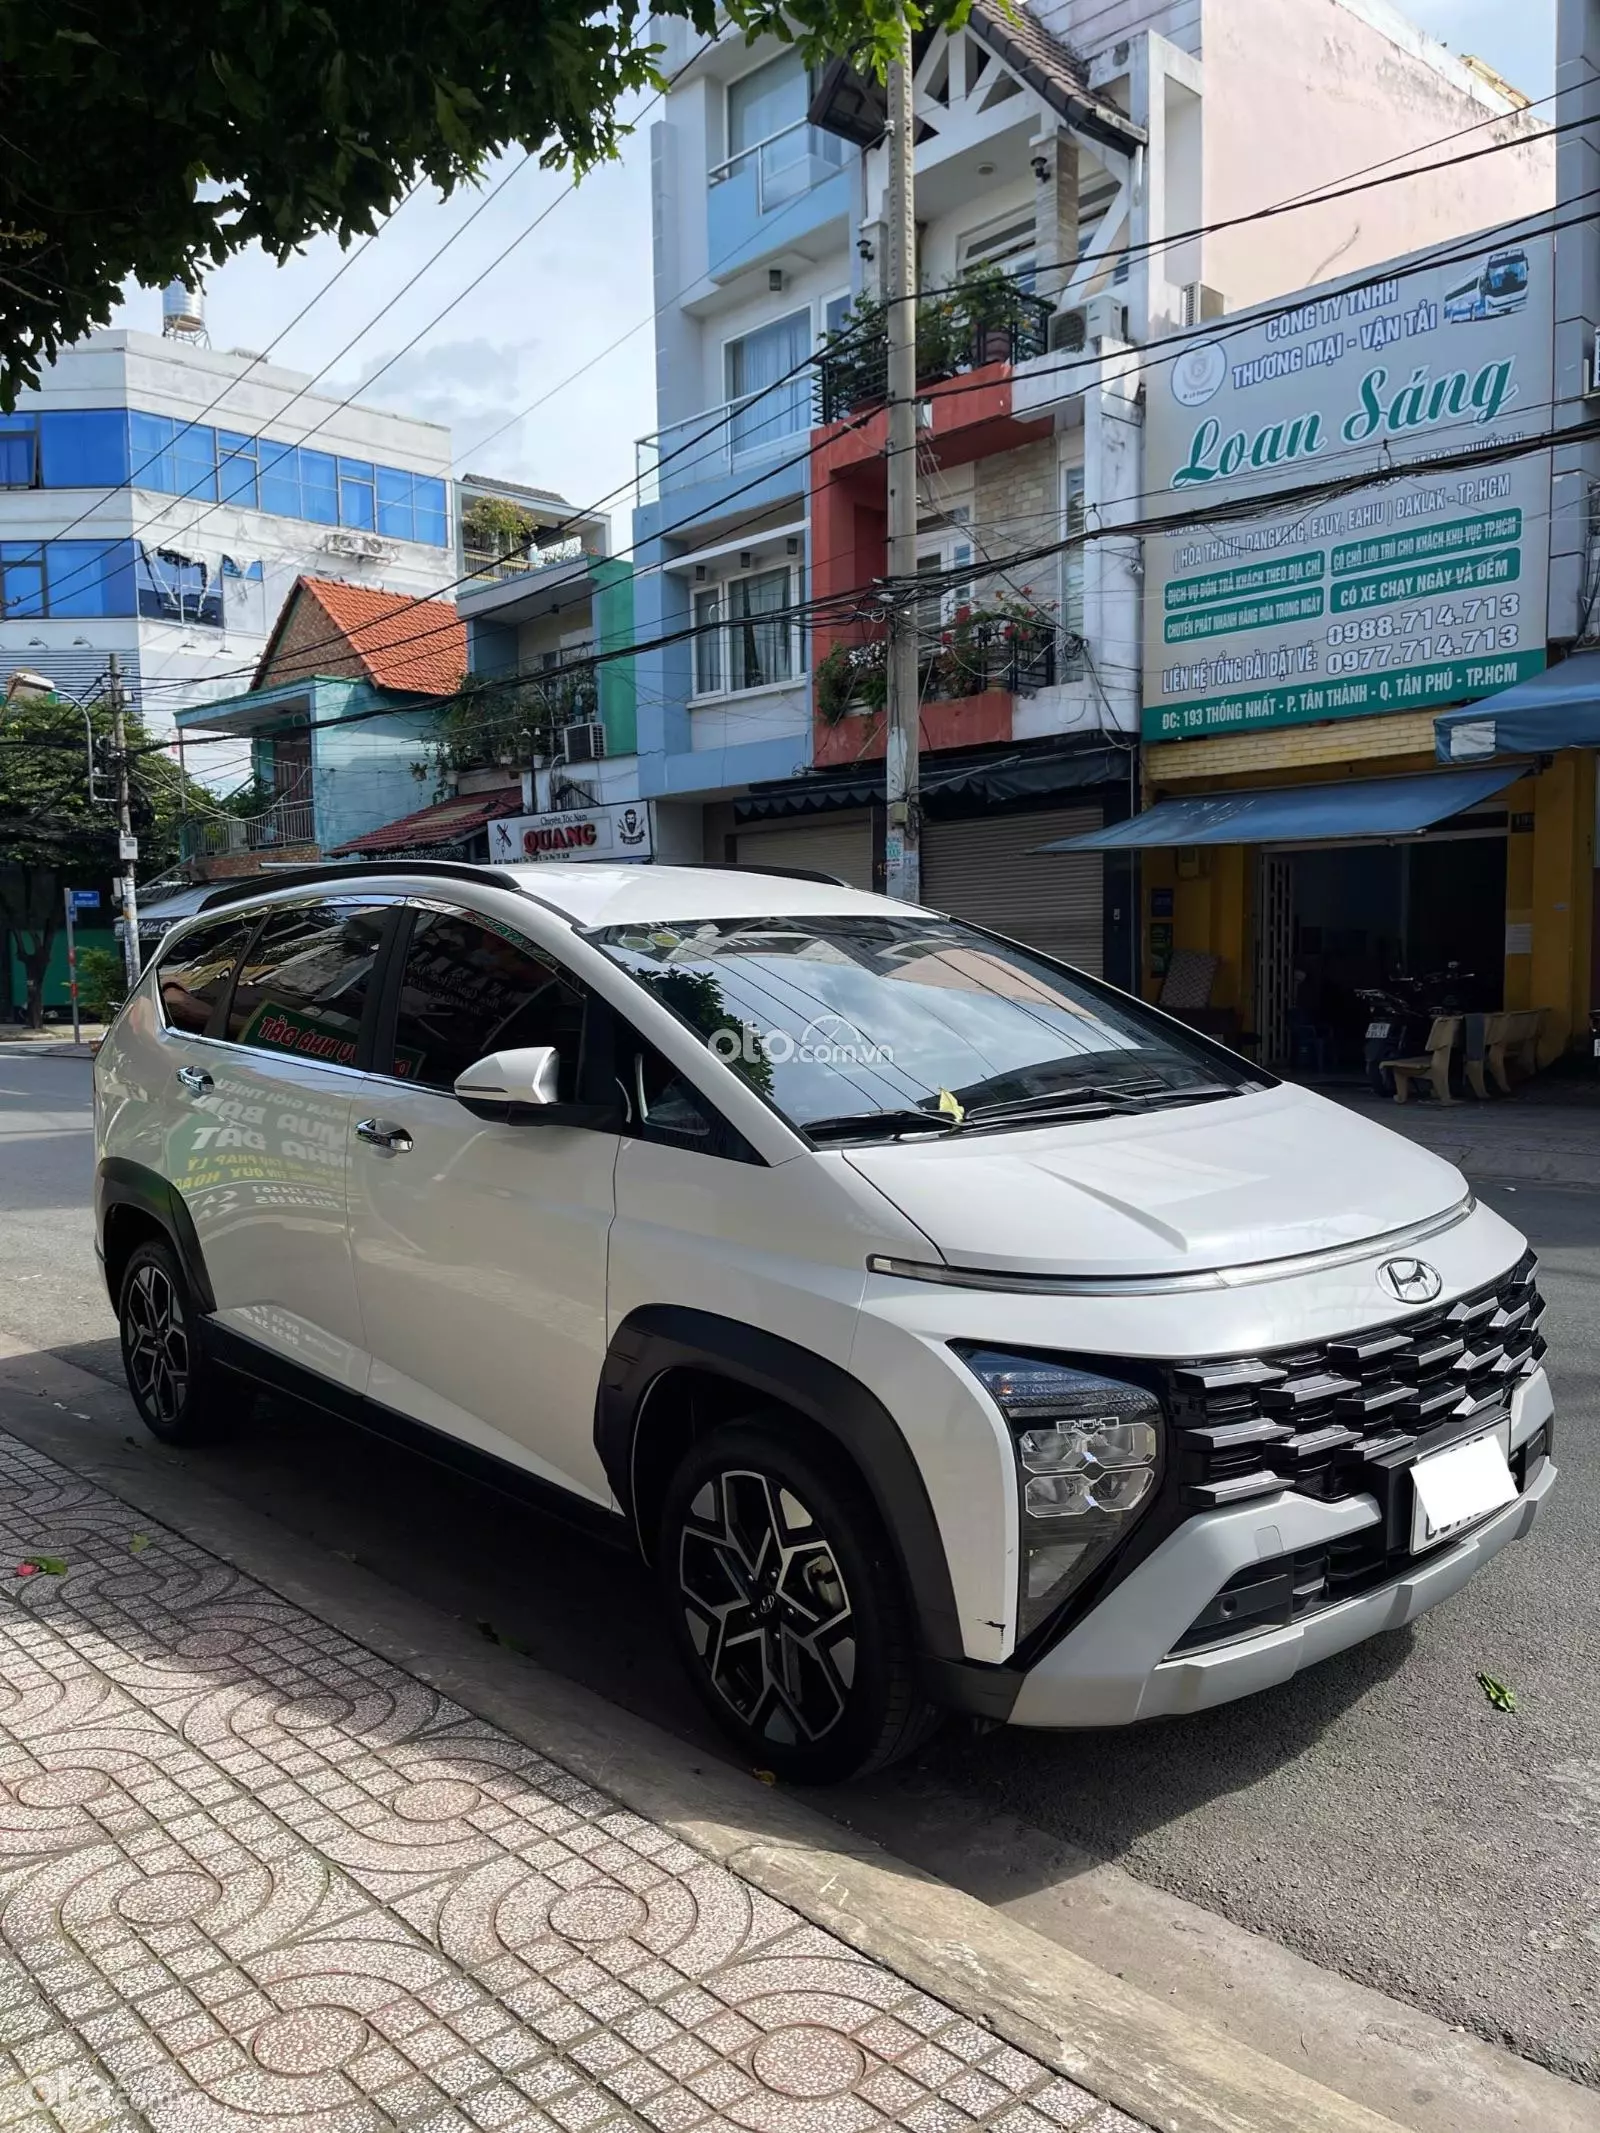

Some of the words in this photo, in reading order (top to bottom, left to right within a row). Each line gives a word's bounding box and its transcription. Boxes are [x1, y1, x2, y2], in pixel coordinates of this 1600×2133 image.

[1320, 294, 1343, 324] TY
[1346, 279, 1398, 316] TNHH
[1232, 347, 1303, 389] THƯƠNG
[1306, 333, 1344, 366] MẠI
[1360, 315, 1402, 351] VẬN
[1404, 299, 1438, 336] TẢI
[1171, 412, 1326, 489] Loan
[1341, 355, 1519, 446] Sáng
[1457, 472, 1512, 505] TP.HCM
[1397, 536, 1414, 557] CHO
[1236, 570, 1263, 590] KHÁCH
[1265, 564, 1287, 585] THEO
[1340, 585, 1358, 607] CÓ
[1361, 585, 1376, 602] XE
[1380, 576, 1413, 601] CHẠY
[1416, 567, 1452, 593] NGÀY
[1456, 562, 1473, 585] VÀ
[1275, 600, 1299, 620] TRONG
[1327, 592, 1520, 647] 0988.714.713
[1162, 661, 1189, 694] LIÊN
[1191, 657, 1207, 693] HỆ
[1210, 650, 1242, 687] TỔNG
[1244, 649, 1267, 681] ĐÀI
[1269, 644, 1296, 681] ĐẶT
[1326, 624, 1519, 675] 0977.714.713
[1183, 709, 1202, 728] 193
[1206, 699, 1243, 724] THỐNG
[1245, 693, 1276, 719] NHẤT
[1287, 695, 1297, 713] P.
[1300, 689, 1323, 711] TÂN
[1326, 683, 1368, 708] THÀNH
[1380, 681, 1392, 701] Q.
[1396, 674, 1421, 697] TÂN
[1425, 667, 1453, 693] PHÚ
[1466, 662, 1518, 688] TP.HCM
[524, 824, 597, 856] QUANG
